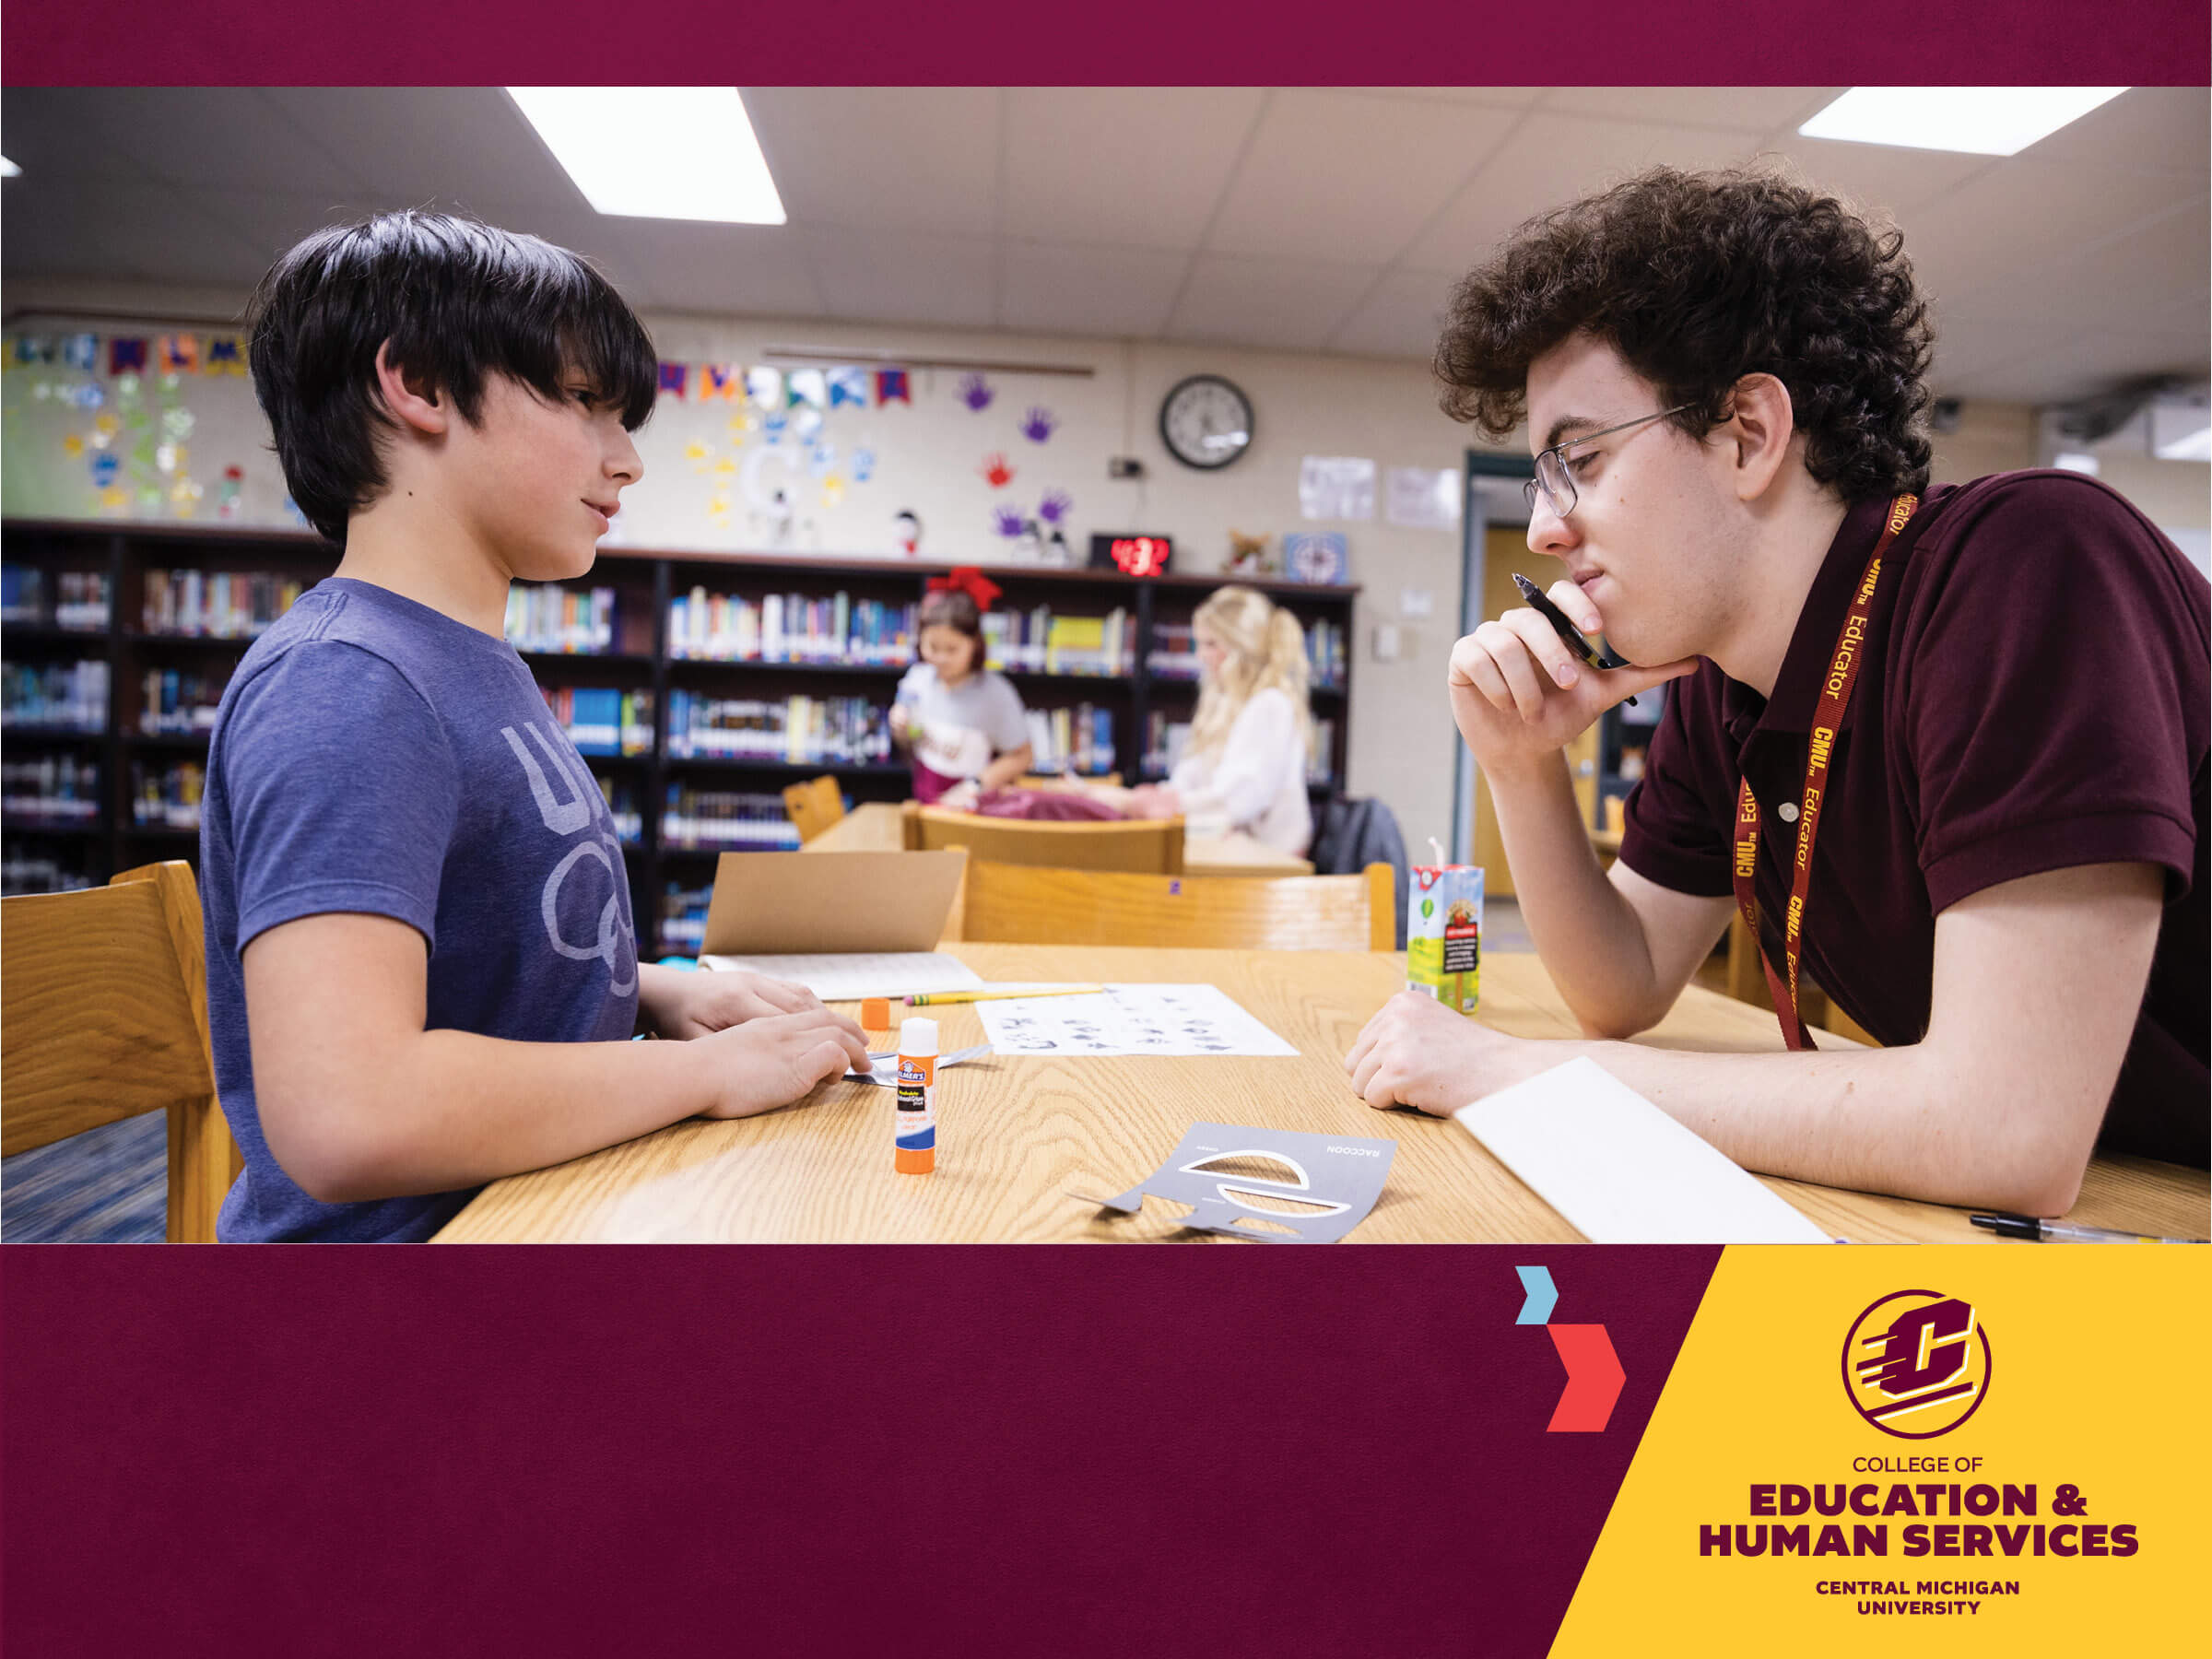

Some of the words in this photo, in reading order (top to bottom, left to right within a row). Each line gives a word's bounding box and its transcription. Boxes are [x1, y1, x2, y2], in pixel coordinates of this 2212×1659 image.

[1826, 615, 1868, 700] Educator
[1797, 787, 1819, 871] Educator
[1326, 1146, 1380, 1158] RACCOON
